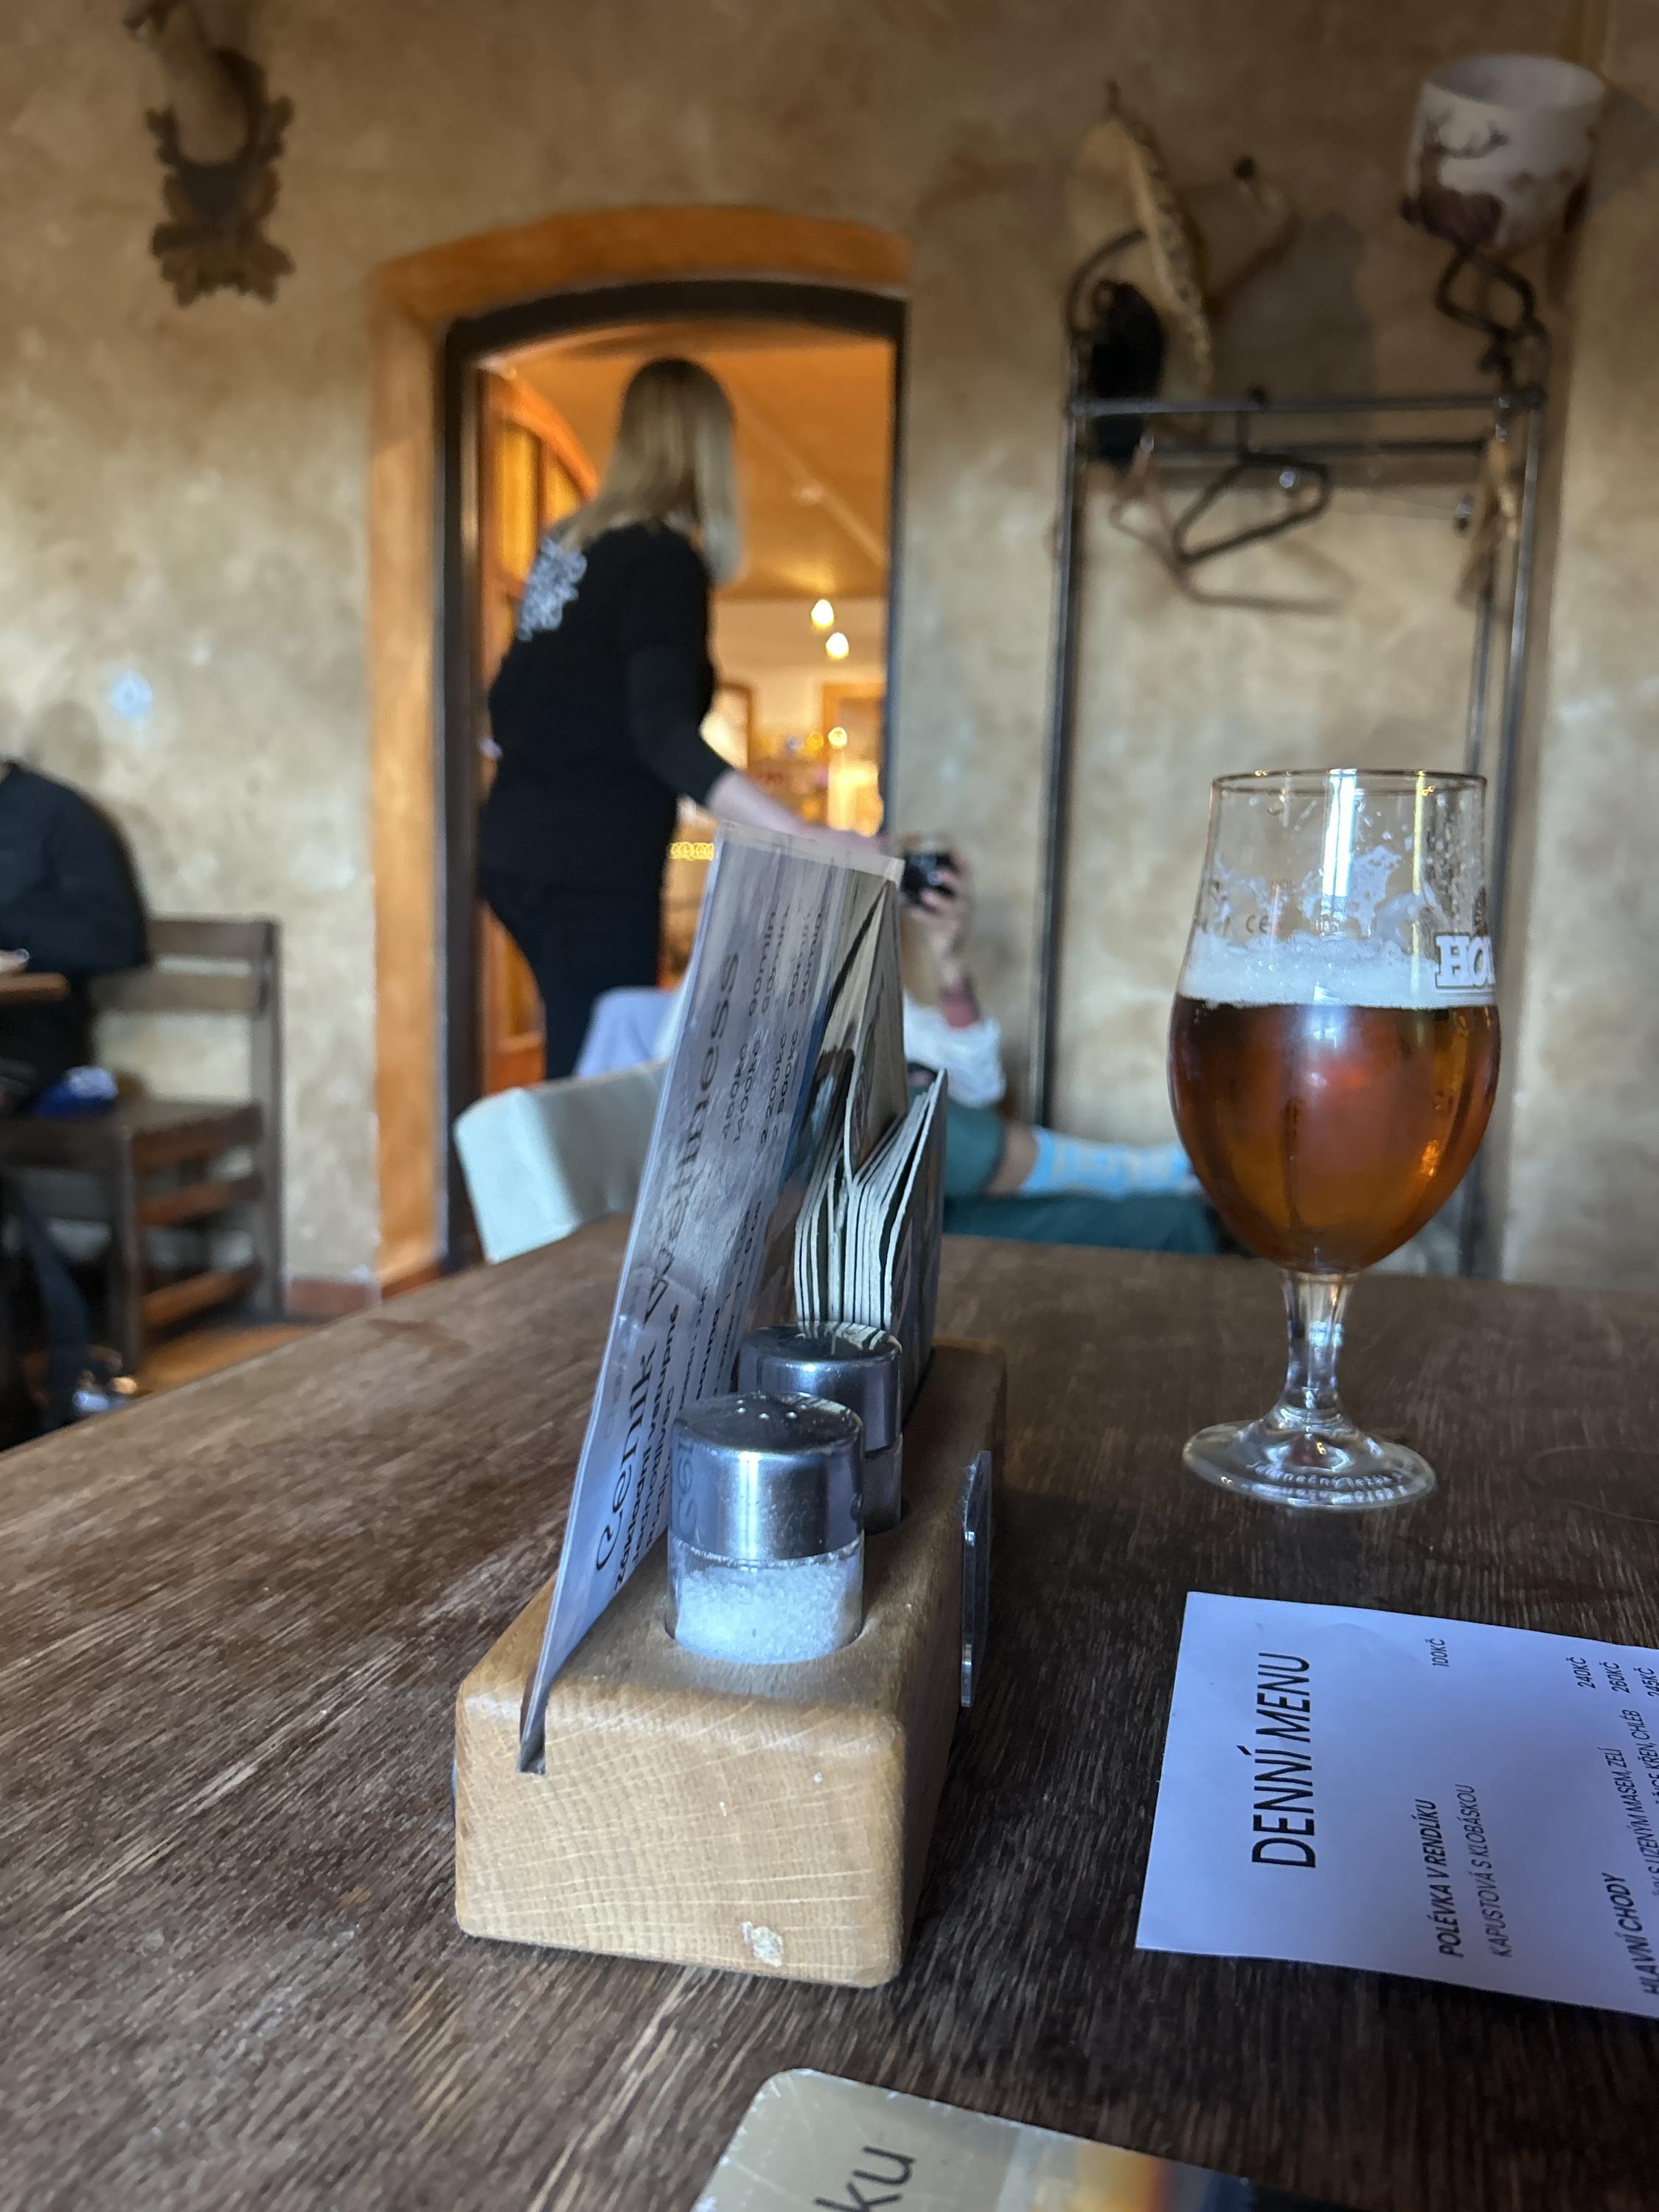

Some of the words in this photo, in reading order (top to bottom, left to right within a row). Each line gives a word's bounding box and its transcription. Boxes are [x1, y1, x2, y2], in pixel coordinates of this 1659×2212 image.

[1424, 1638, 1450, 1666] 100KČ
[1565, 1657, 1596, 1688] 240KČ
[1599, 1661, 1630, 1694] 260KČ
[1632, 1666, 1659, 1697] 245KČ
[1255, 1652, 1311, 1743] MENU
[1619, 1708, 1650, 1741] CHLÉB
[1597, 1746, 1627, 1768] ZELÍ
[1635, 1742, 1659, 1770] KŘEN,
[1237, 1745, 1316, 1868] DENNÍ
[1610, 1770, 1645, 1813] MASEM,
[1411, 1799, 1447, 1866] RENDLÍKU
[1455, 1784, 1489, 1858] KLOBÁSKOU
[1626, 1813, 1659, 1864] UZENÝM
[1426, 1867, 1450, 1879] V
[1470, 1858, 1492, 1868] S
[1467, 1871, 1512, 1958] KAPUSTOVÁ
[1601, 1872, 1643, 1932] CHODY
[1427, 1885, 1464, 1958] POLÉVKA
